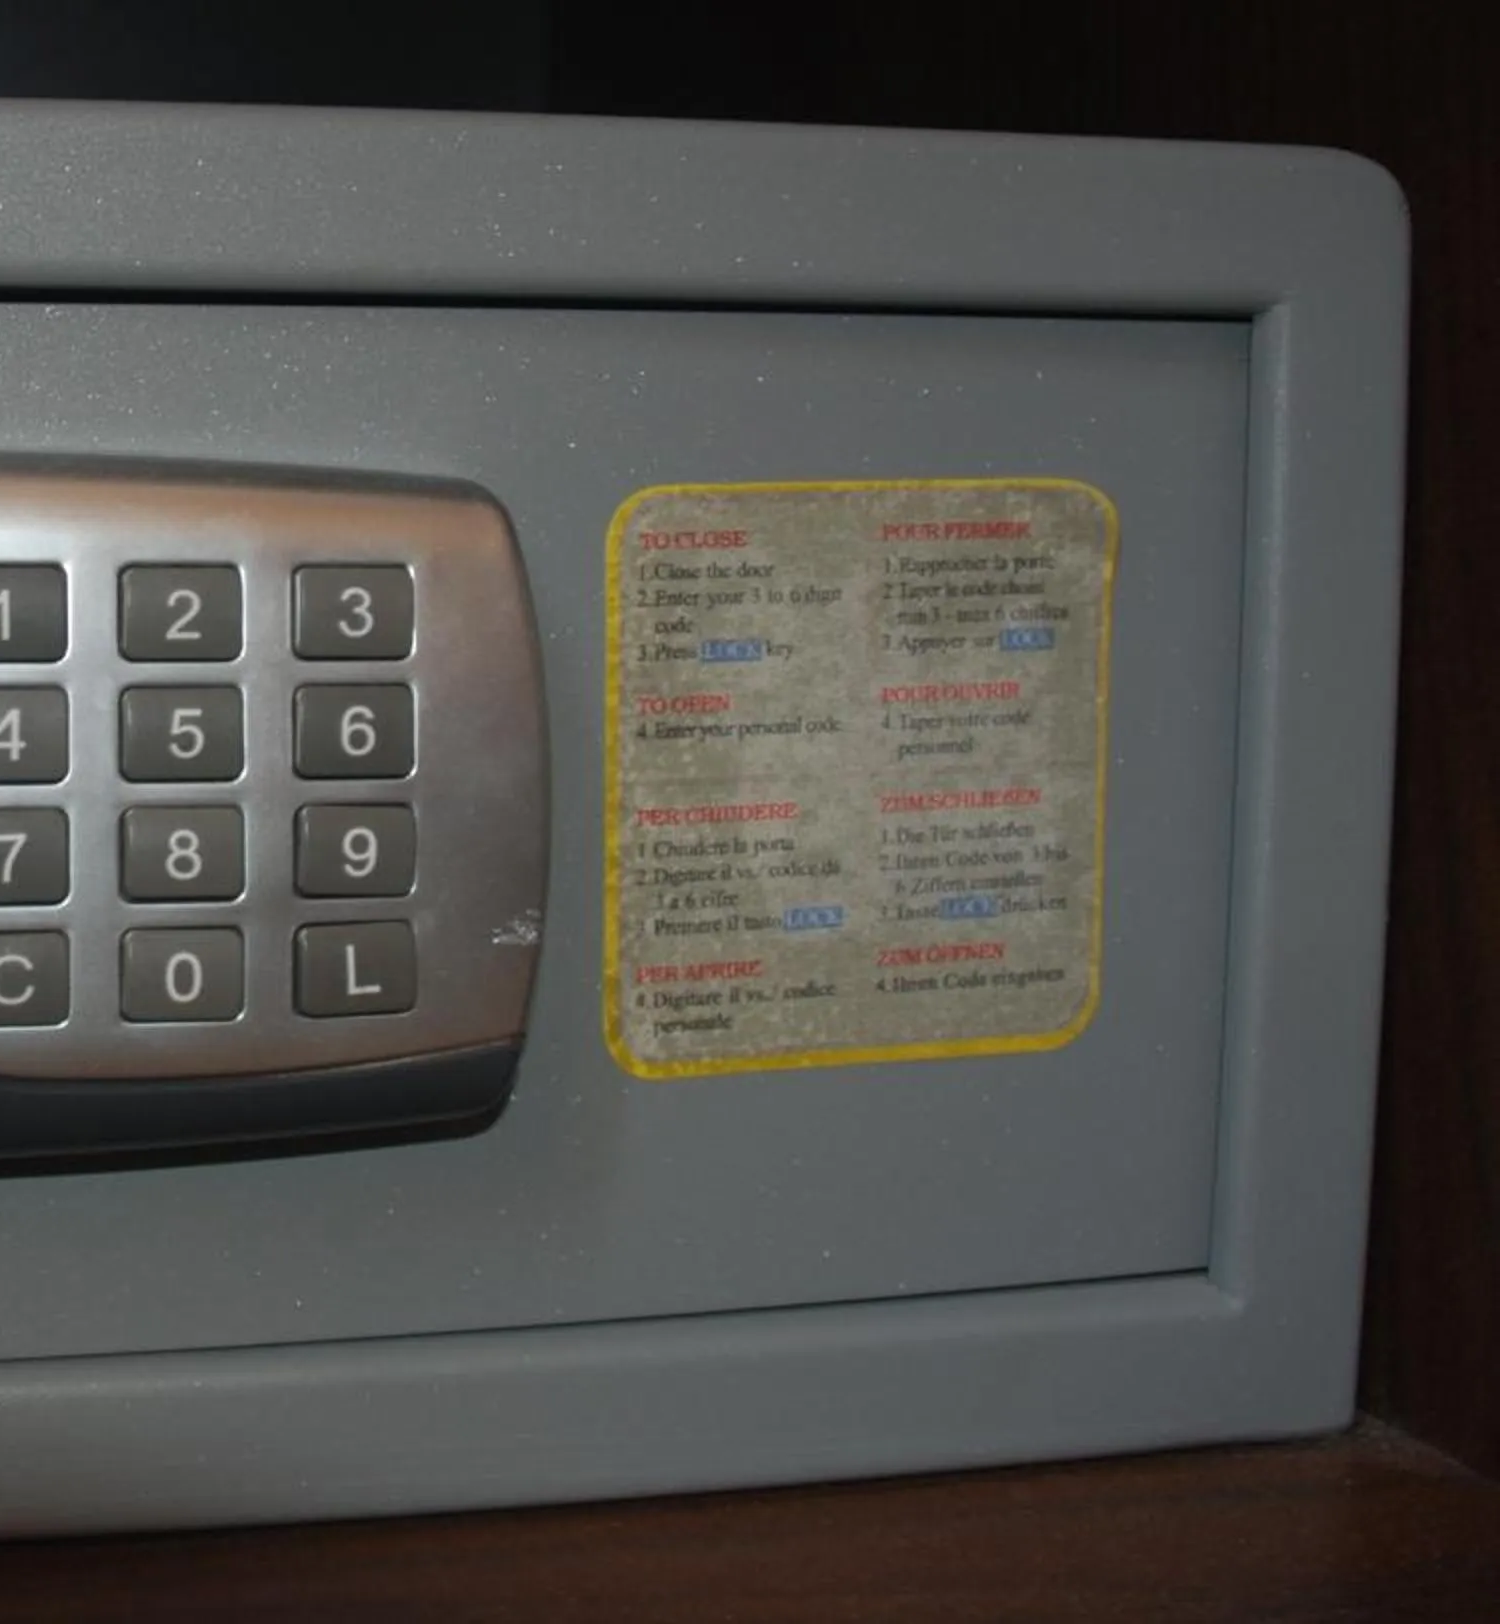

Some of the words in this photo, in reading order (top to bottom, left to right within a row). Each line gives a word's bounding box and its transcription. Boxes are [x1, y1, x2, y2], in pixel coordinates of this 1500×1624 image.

[640, 532, 670, 549] TO
[676, 530, 748, 548] CLOSE
[883, 523, 939, 541] POUR
[943, 522, 1030, 540] FERMER
[706, 562, 731, 578] the
[736, 561, 774, 578] door
[705, 591, 744, 609] your
[752, 588, 761, 604] 3
[768, 588, 783, 604] to
[962, 581, 997, 597] code
[165, 589, 202, 640] 2
[338, 586, 374, 638] 3
[931, 607, 941, 623] 3
[655, 617, 693, 634] code
[766, 641, 793, 660] key
[882, 685, 939, 703] POUR
[942, 680, 1020, 699] OUVRIR
[637, 696, 666, 715] TO
[671, 693, 730, 713] OPEN
[991, 710, 1030, 726] code
[168, 708, 205, 759] 5
[340, 705, 377, 756] 6
[700, 725, 733, 741] your
[738, 717, 801, 741] personal
[805, 716, 842, 733] code
[880, 795, 924, 813] ZUM
[637, 808, 680, 826] PER
[686, 802, 799, 823] CHIUDERE
[165, 829, 202, 880] 8
[341, 827, 378, 878] 9
[734, 837, 748, 853] la
[754, 837, 795, 857] porta
[946, 850, 987, 866] Code
[992, 850, 1024, 865] von
[721, 864, 732, 881] il
[701, 890, 738, 908] cifre
[727, 915, 739, 931] il
[876, 949, 920, 967] ZUM
[346, 944, 382, 995] L
[637, 965, 678, 983] PER
[684, 961, 762, 980] APRIRE
[943, 971, 986, 989] Code
[729, 988, 742, 1003] il
